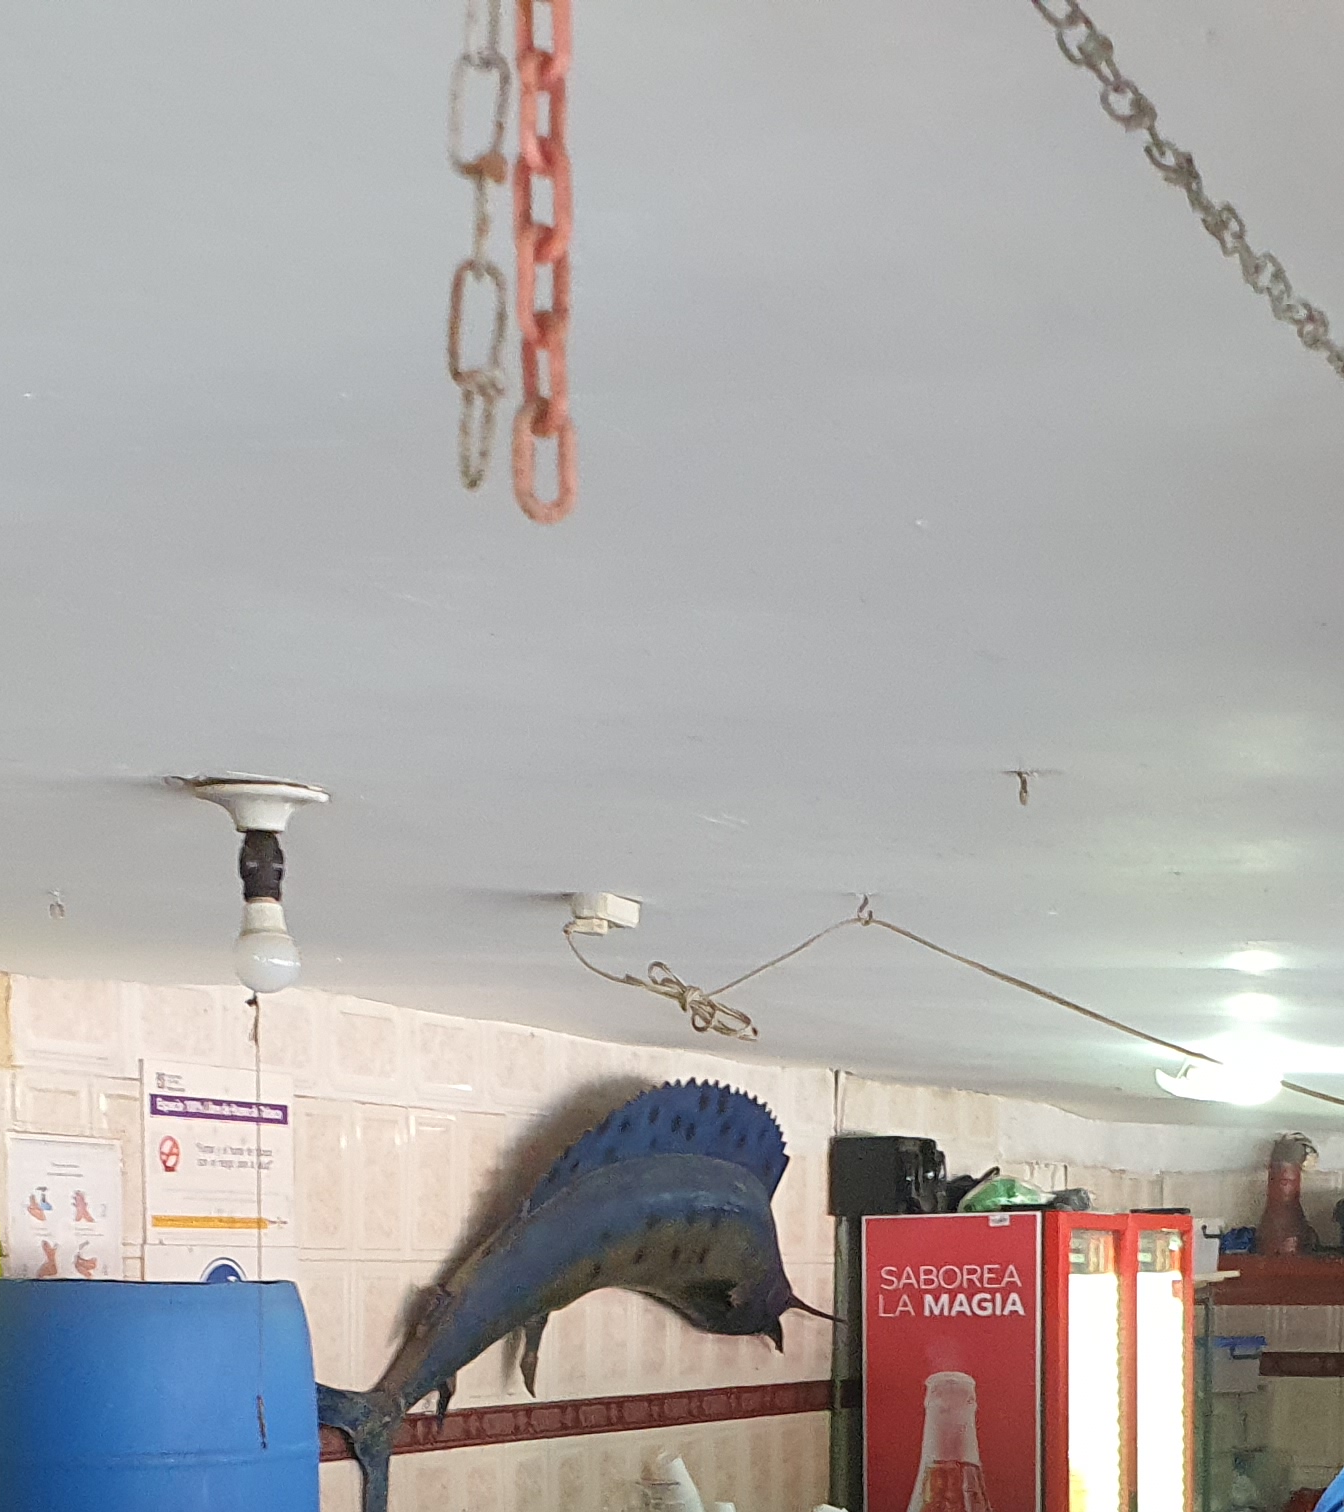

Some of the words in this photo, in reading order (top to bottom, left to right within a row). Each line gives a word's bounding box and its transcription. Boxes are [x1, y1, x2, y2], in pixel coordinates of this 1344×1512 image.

[880, 1264, 1022, 1290] SABOREA
[878, 1294, 915, 1317] LA
[924, 1292, 1025, 1317] MAGIA
